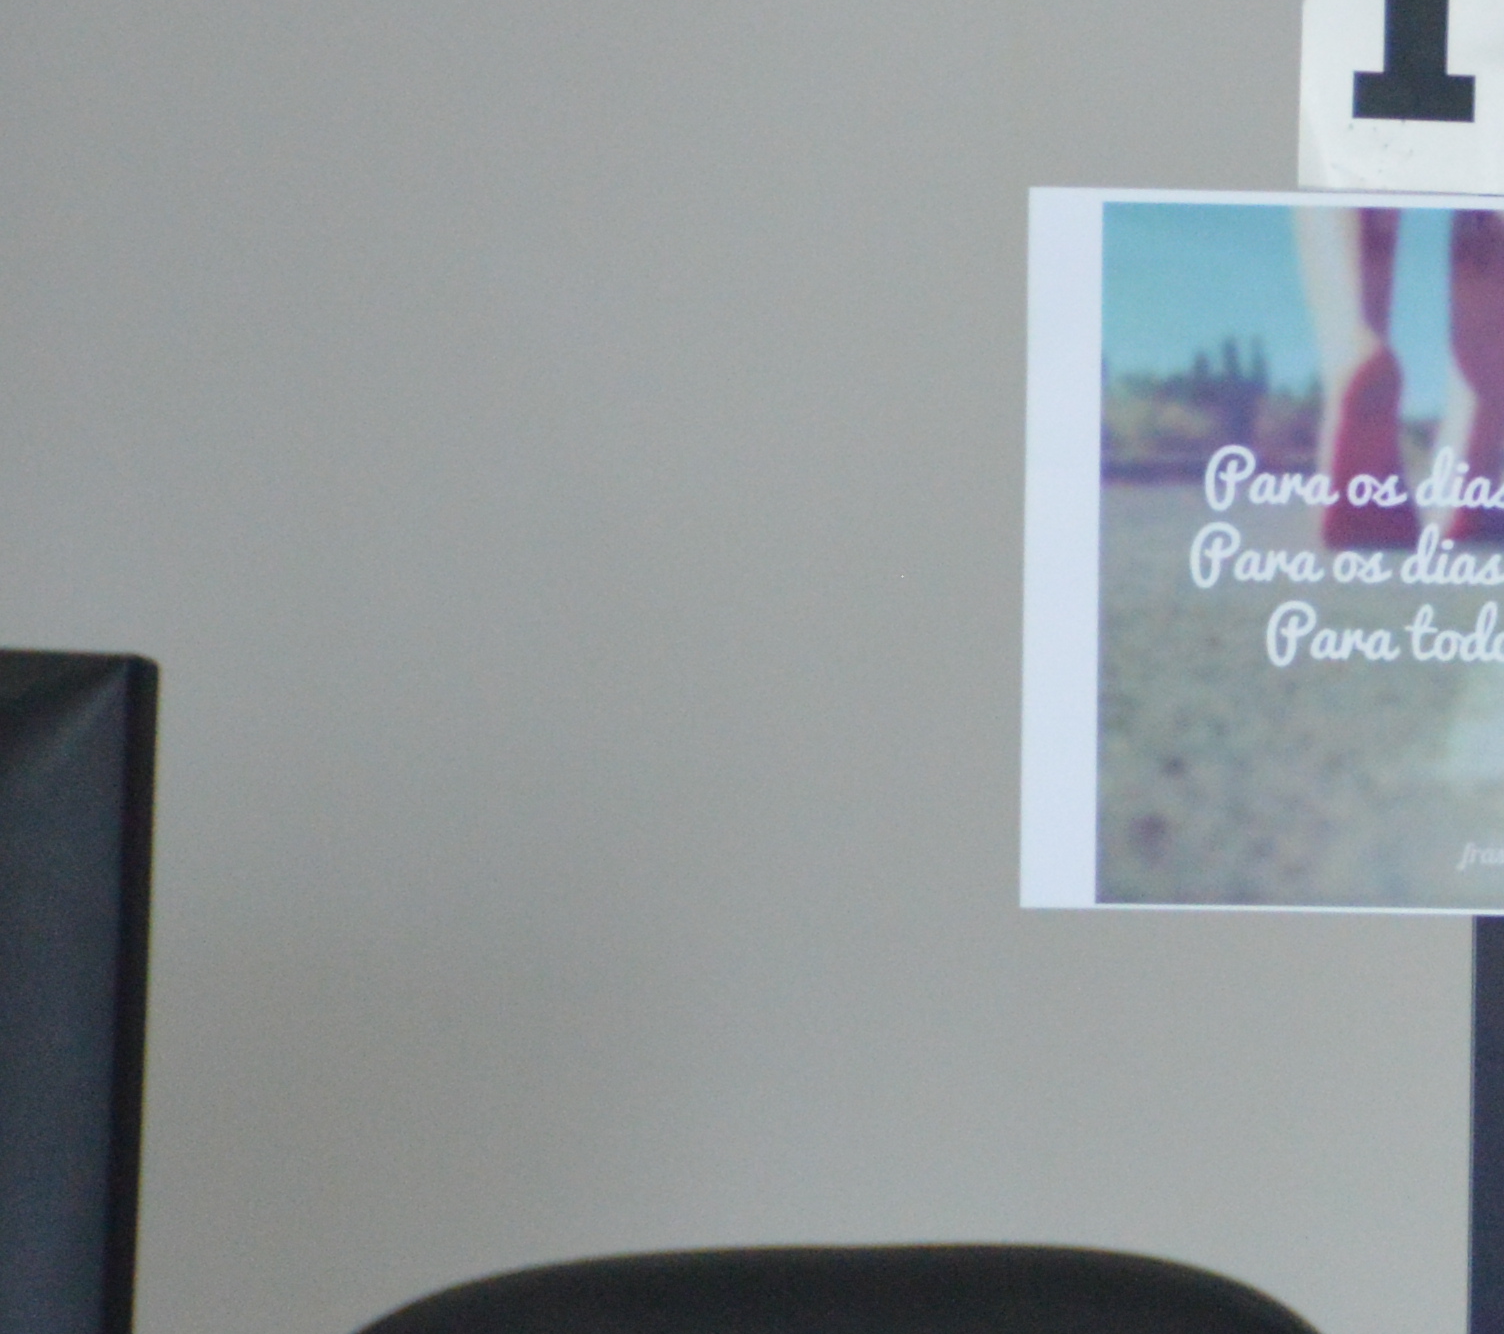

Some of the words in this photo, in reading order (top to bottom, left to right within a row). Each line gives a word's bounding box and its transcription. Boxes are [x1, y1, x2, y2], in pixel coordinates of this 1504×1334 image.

[1205, 445, 1339, 511] Para
[1347, 473, 1407, 507] os
[1190, 521, 1325, 588] Para
[1333, 550, 1392, 583] os
[1266, 600, 1401, 666] Para
